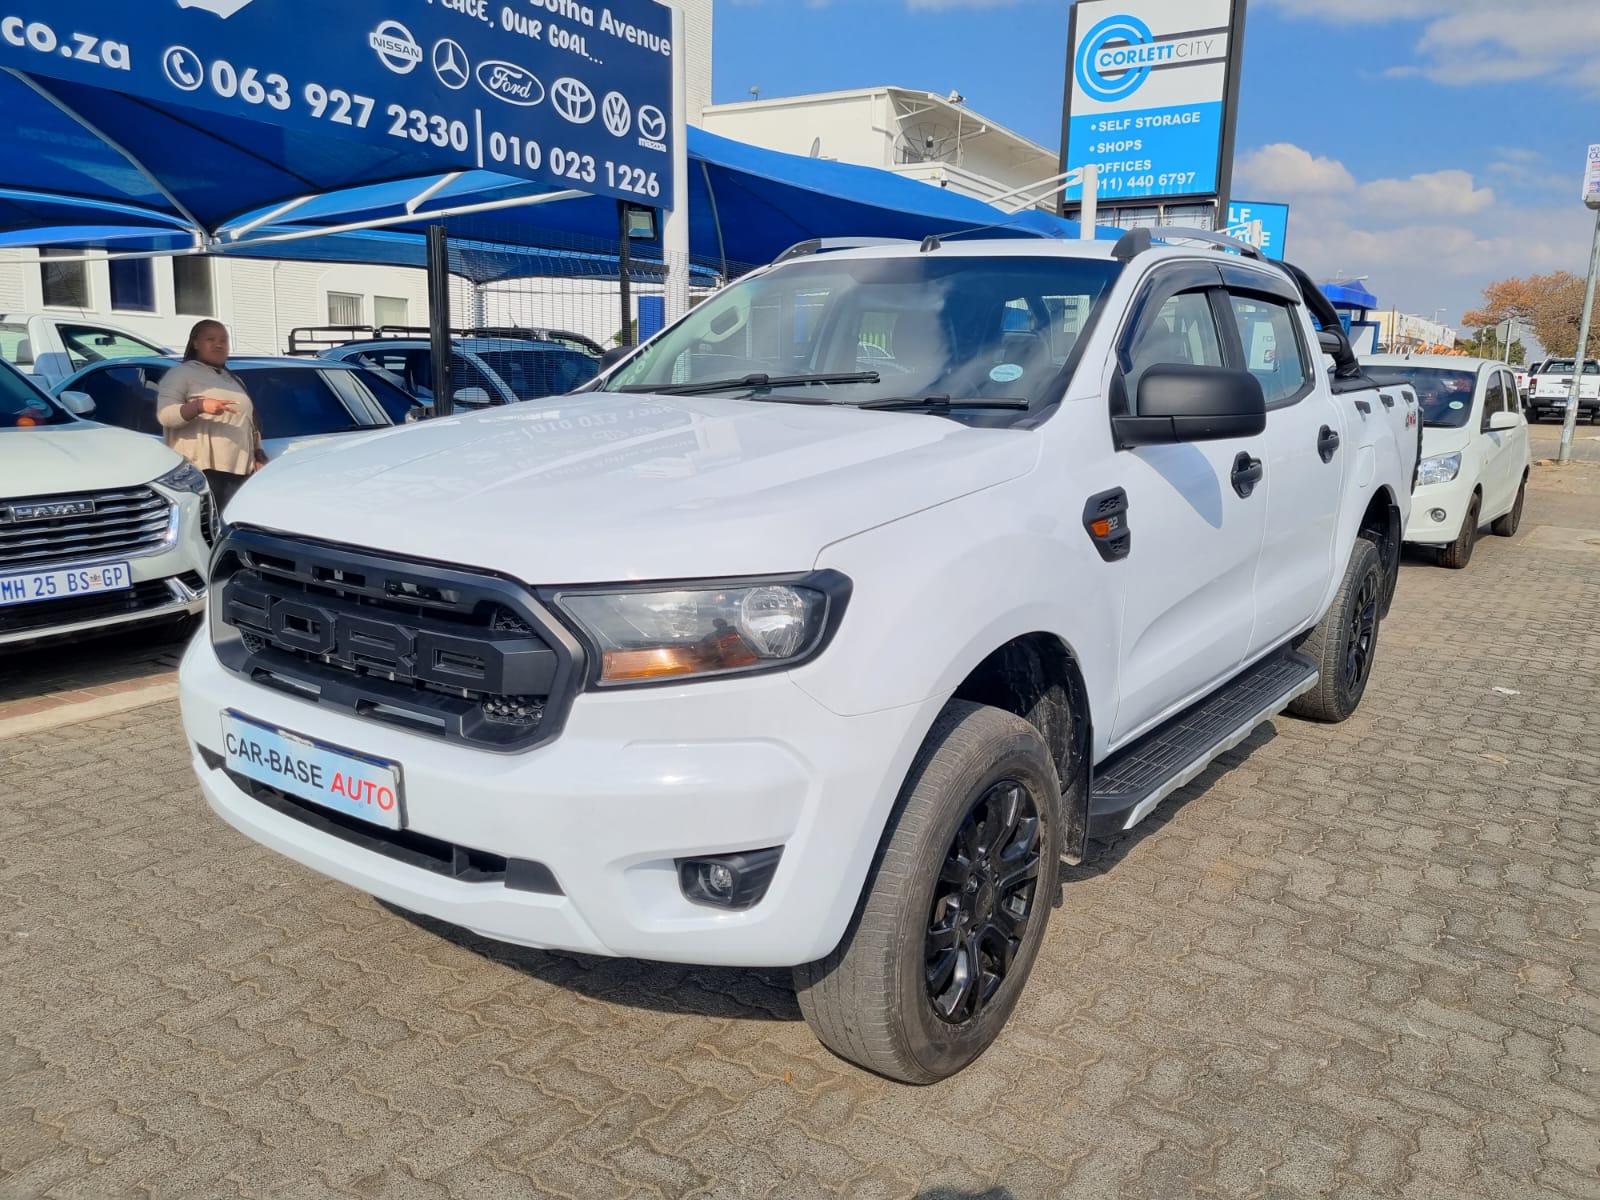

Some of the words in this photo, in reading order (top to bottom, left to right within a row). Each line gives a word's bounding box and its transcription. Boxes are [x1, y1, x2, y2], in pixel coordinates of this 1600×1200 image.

[502, 7, 542, 41] OUR
[600, 8, 671, 56] Avenue
[1, 16, 131, 71] co.za
[373, 36, 420, 59] NISSAN
[489, 66, 533, 98] Ford
[211, 59, 291, 111] 063
[304, 83, 375, 129] 927
[387, 104, 469, 152] 2330
[1098, 118, 1131, 132] SELF
[1135, 112, 1201, 129] STORAGE
[638, 137, 667, 153] mazda
[1097, 139, 1143, 154] SHOPS
[489, 131, 542, 170] 010
[550, 147, 596, 183] 023
[604, 161, 660, 198] 1226
[1096, 159, 1152, 175] OFFICES
[1097, 176, 1123, 192] 11)
[1127, 174, 1154, 188] 440
[1158, 172, 1196, 186] 6797
[1229, 206, 1252, 224] LF
[15, 502, 93, 522] HAVAL
[1, 578, 26, 600] MH
[34, 575, 57, 596] 25
[67, 571, 90, 592] BS
[102, 566, 123, 587] GP
[223, 578, 506, 697] FORD
[226, 732, 324, 789] CAR-BASE
[331, 772, 395, 811] AUTO
